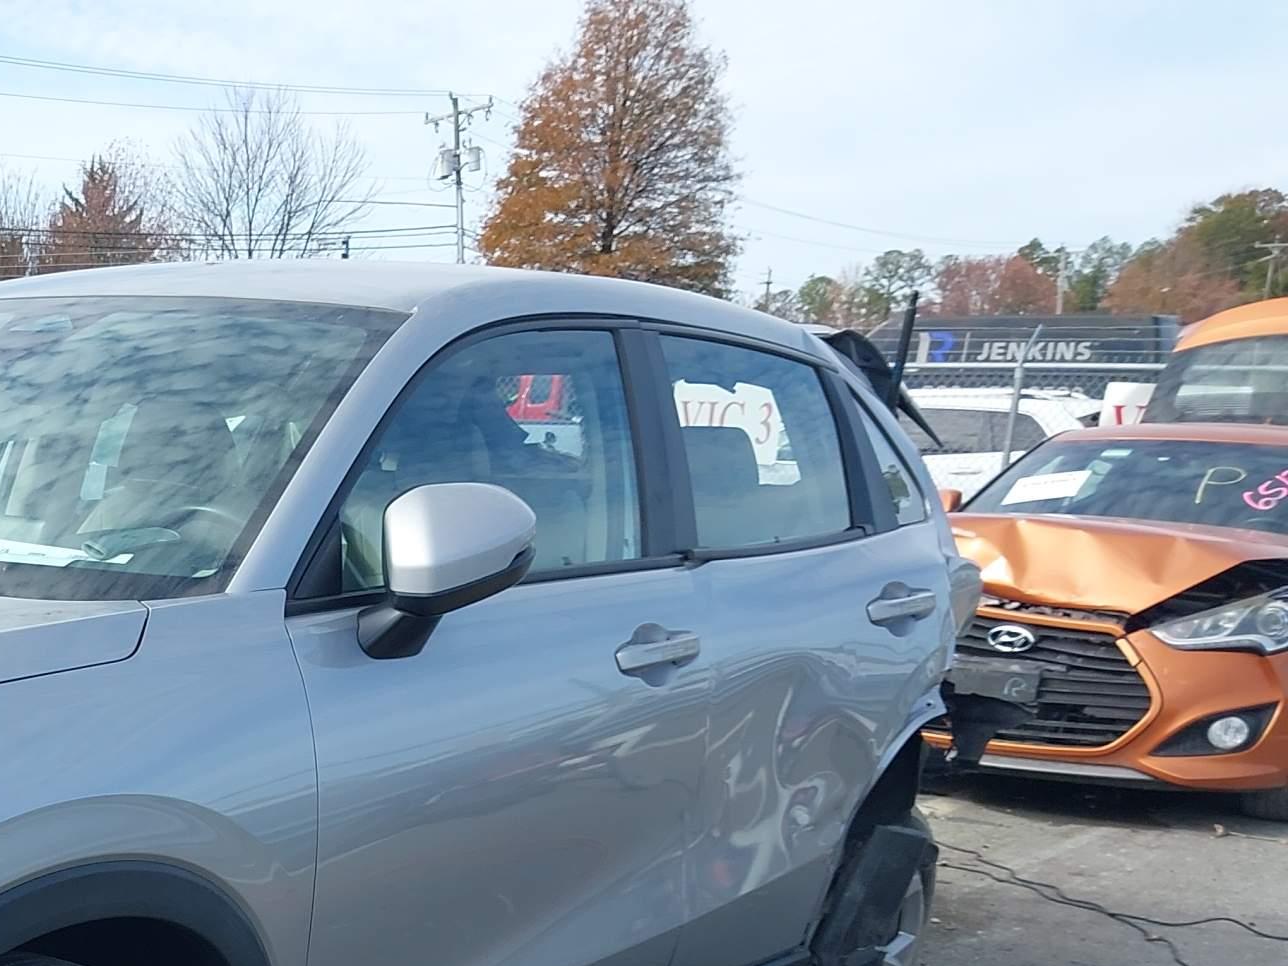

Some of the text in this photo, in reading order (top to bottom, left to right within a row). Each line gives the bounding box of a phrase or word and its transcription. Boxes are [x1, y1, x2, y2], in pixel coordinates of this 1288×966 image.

[976, 341, 1092, 361] JENKINS
[755, 402, 773, 445] 3
[1195, 466, 1247, 504] P
